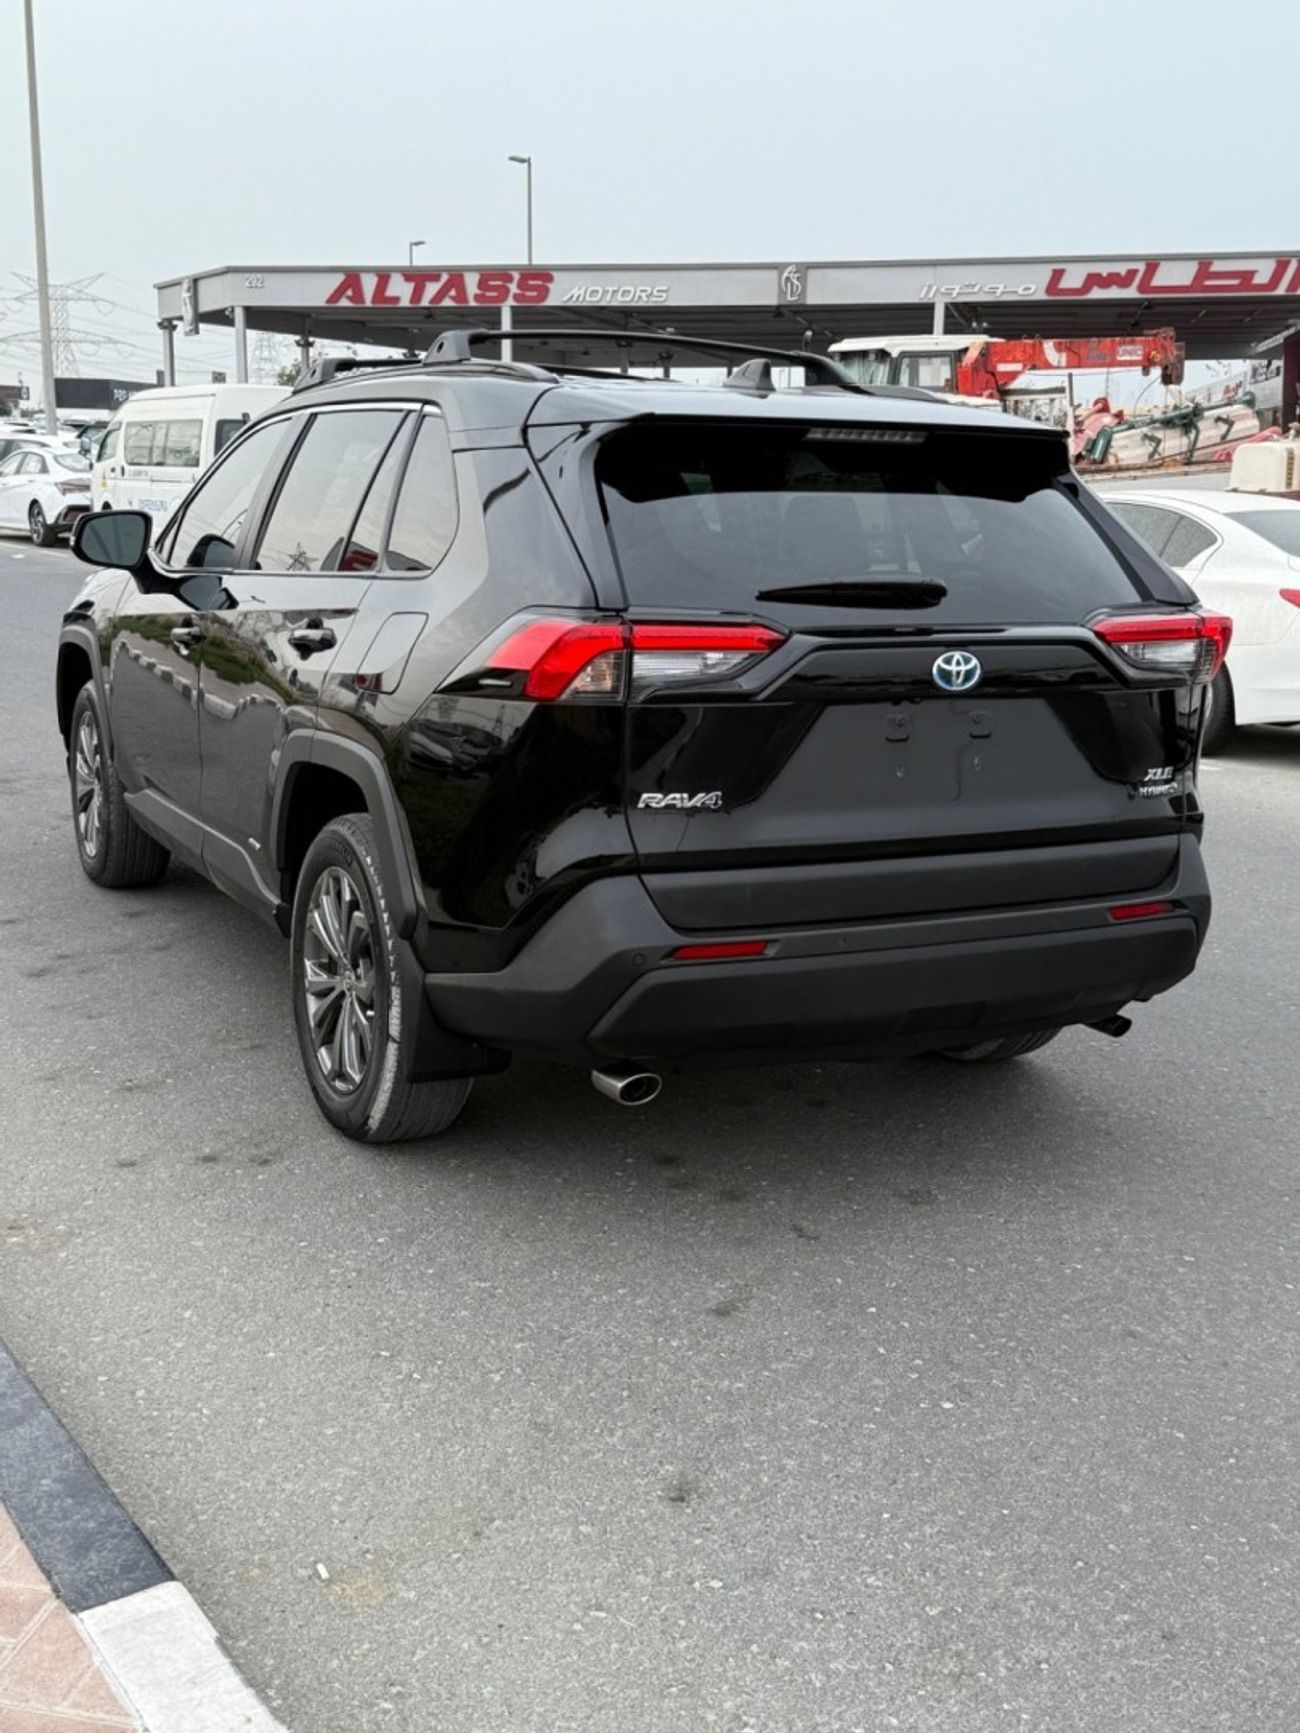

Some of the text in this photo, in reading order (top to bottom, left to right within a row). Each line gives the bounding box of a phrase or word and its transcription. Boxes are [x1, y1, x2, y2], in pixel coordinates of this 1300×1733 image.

[325, 271, 669, 305] ALTASS MOTORS
[1143, 766, 1174, 781] XLE
[637, 791, 722, 808] RAV4
